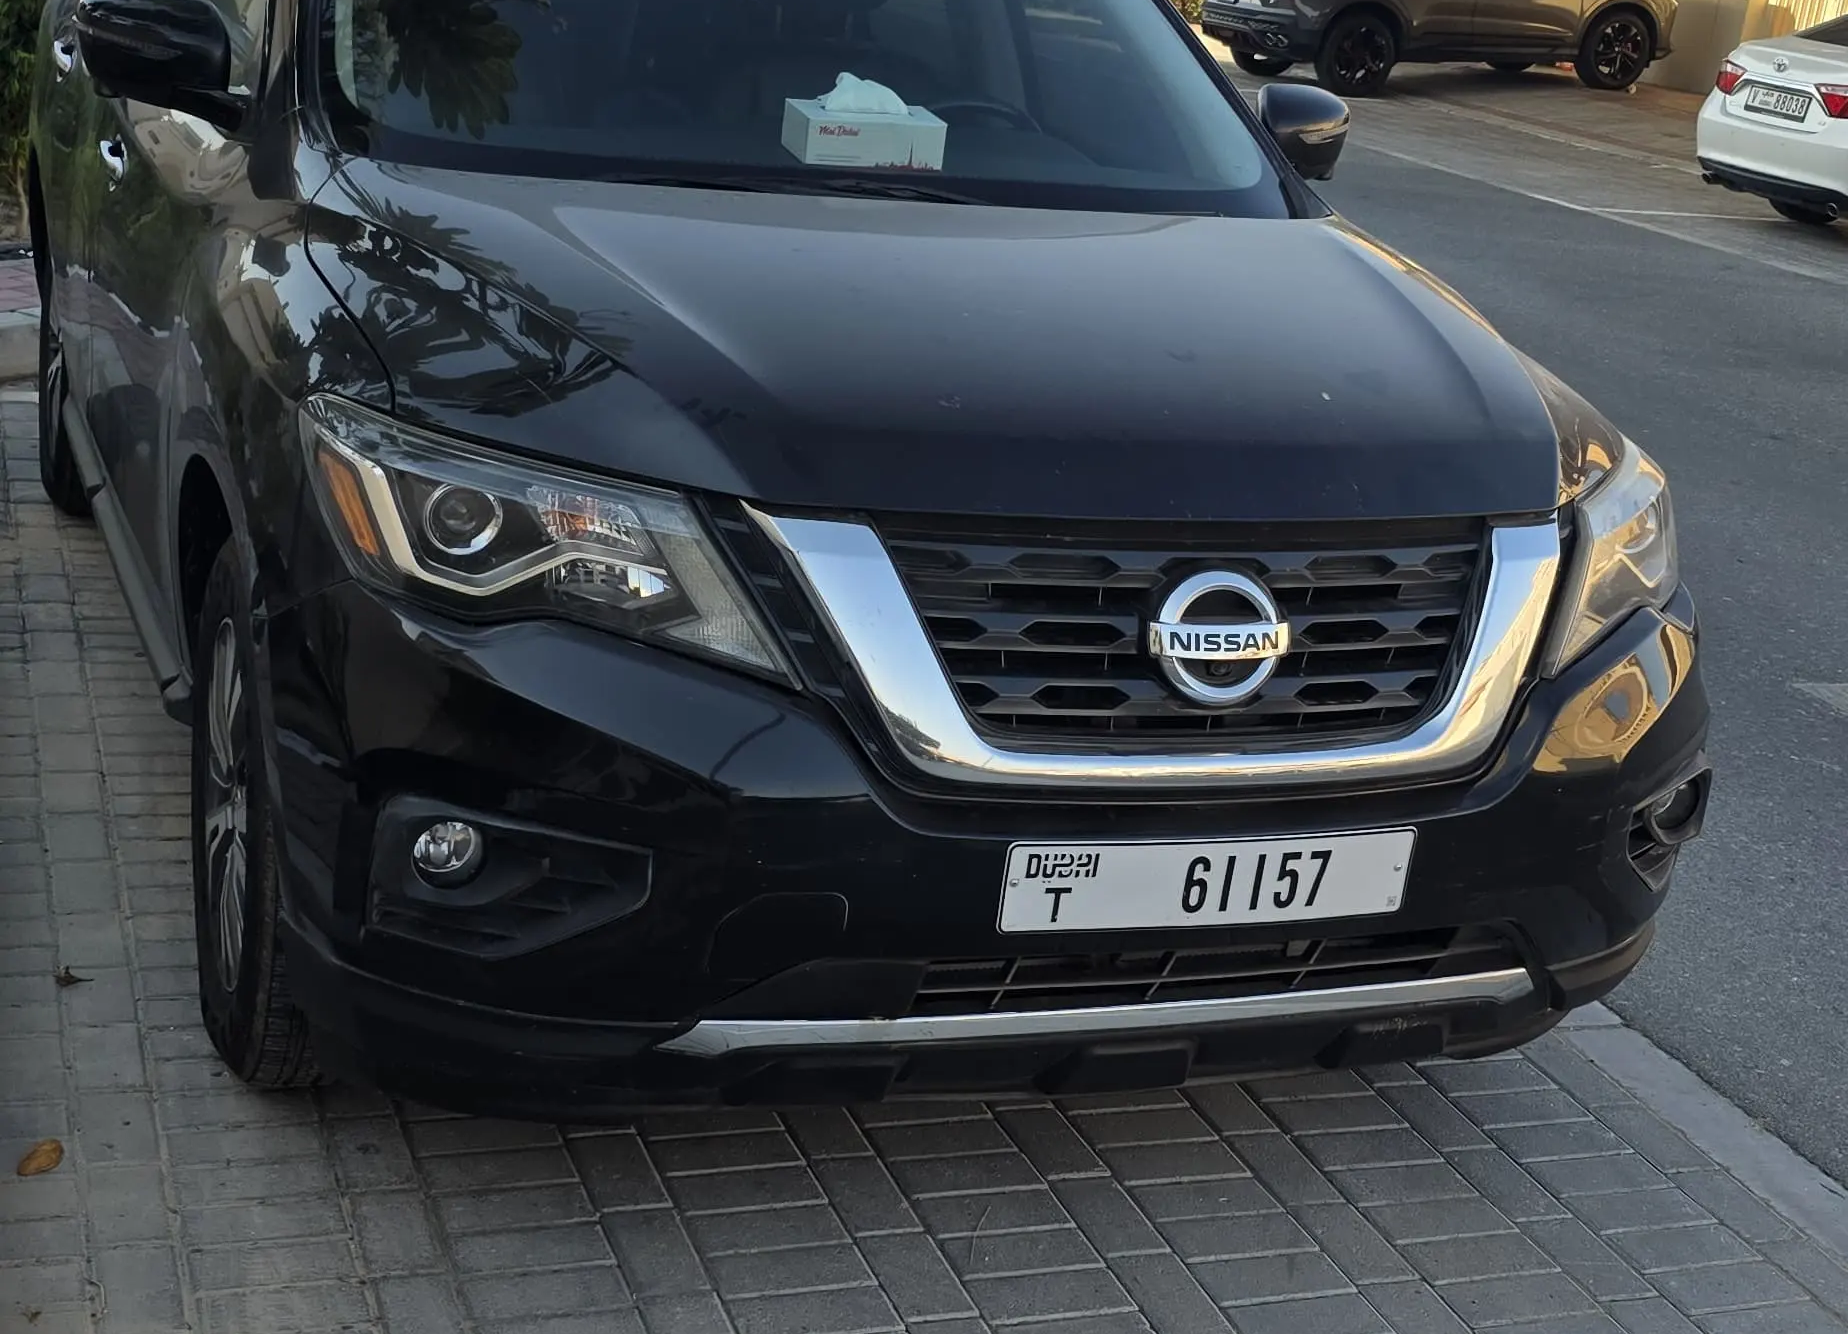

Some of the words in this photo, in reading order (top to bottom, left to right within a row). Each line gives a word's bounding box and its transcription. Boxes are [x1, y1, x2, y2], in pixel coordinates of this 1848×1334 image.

[1169, 630, 1279, 652] NISSAN
[1025, 853, 1100, 879] DUBAI
[1044, 887, 1073, 923] T
[1181, 849, 1333, 914] 61157
